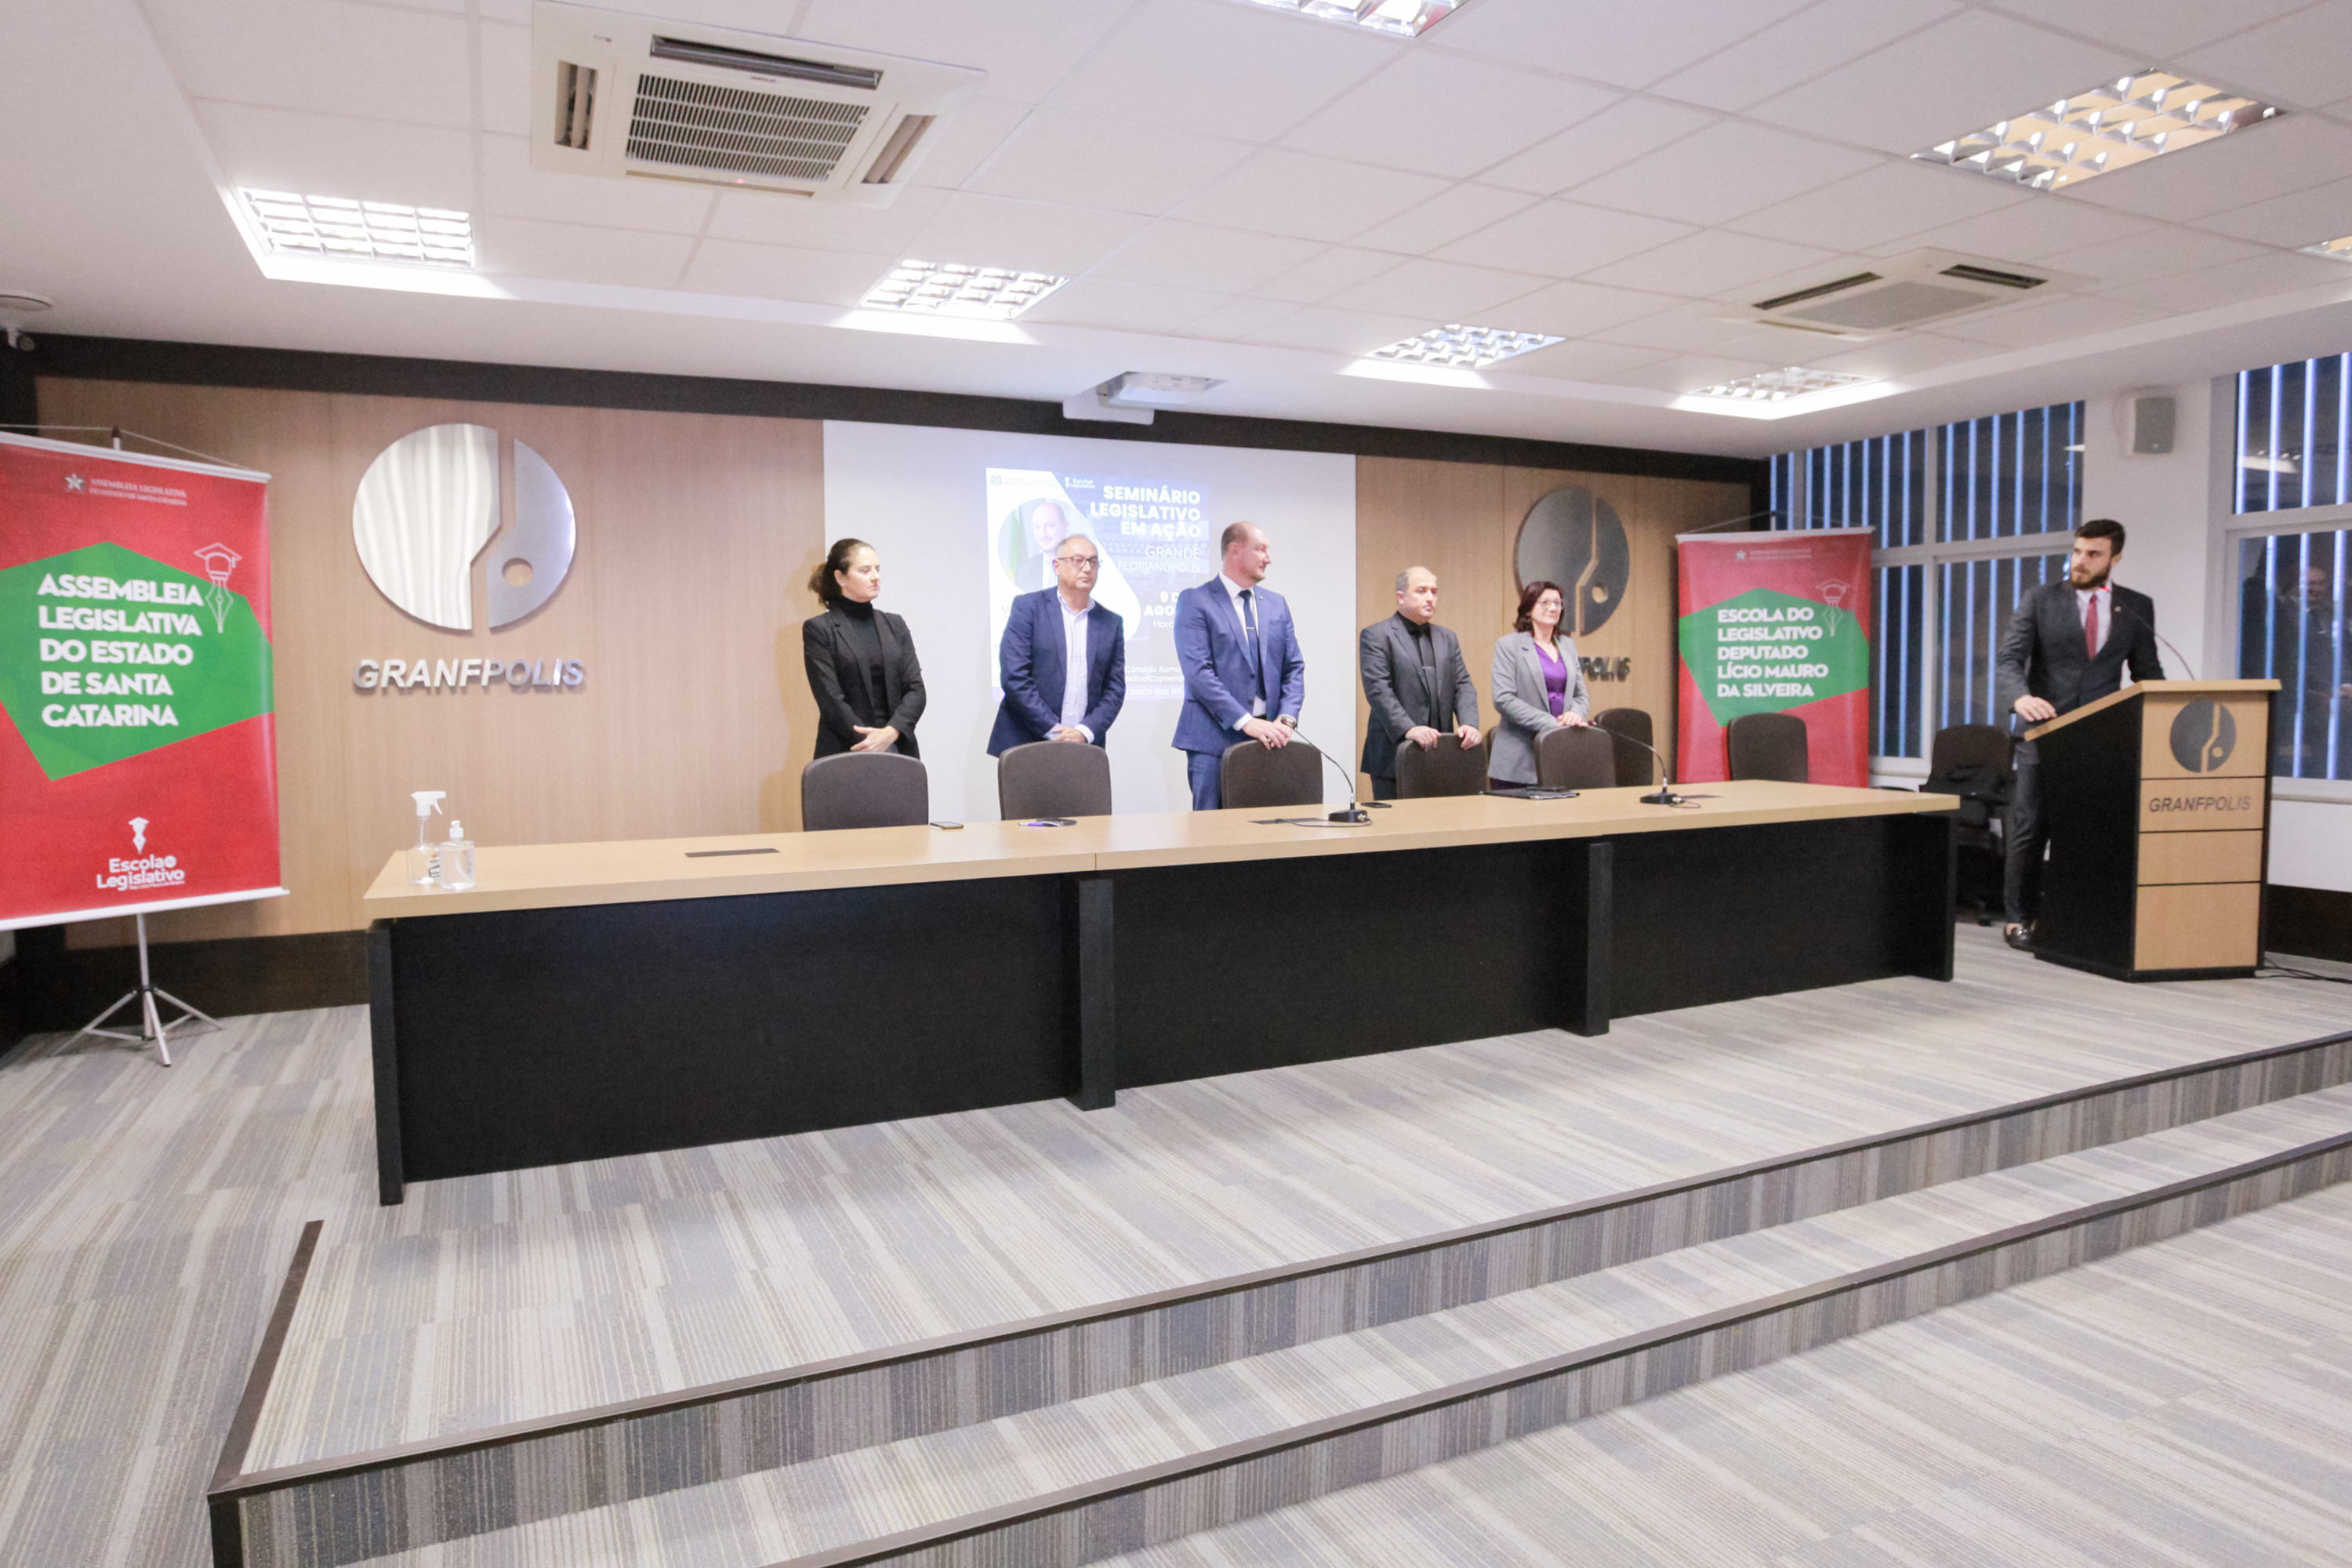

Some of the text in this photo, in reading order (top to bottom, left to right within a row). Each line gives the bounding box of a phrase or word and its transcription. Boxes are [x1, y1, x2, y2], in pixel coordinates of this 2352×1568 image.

[1103, 485, 1201, 504] SEMINÁRIO
[1090, 502, 1201, 521] LEGISLATIVO
[1121, 520, 1201, 541] EM AÇÃO
[1145, 546, 1200, 559] GRANDE
[1117, 560, 1201, 573] FLORIANÓPOLIS
[37, 573, 204, 606] ASSEMBLEIA
[1160, 590, 1168, 603] 9
[1143, 604, 1176, 616] AGO
[1718, 607, 1814, 623] ESCOLA DO
[38, 605, 203, 637] LEGISLATIVA
[1718, 626, 1823, 641] LEGISLATIVO
[39, 638, 194, 666] DO ESTADO
[1718, 645, 1809, 660] DEPUTADO
[353, 659, 584, 688] GRANFPOLIS
[1577, 657, 1631, 679] POLIS
[1718, 662, 1829, 679] LÍCIO MAURO
[41, 671, 174, 695] DE SANTA
[1131, 688, 1153, 697] partir
[1717, 683, 1814, 697] DA SILVEIRA
[42, 704, 180, 727] CATARINA
[2149, 796, 2252, 812] GRANFPOLIS
[109, 854, 165, 873] Escola
[96, 868, 185, 891] Legislativo
